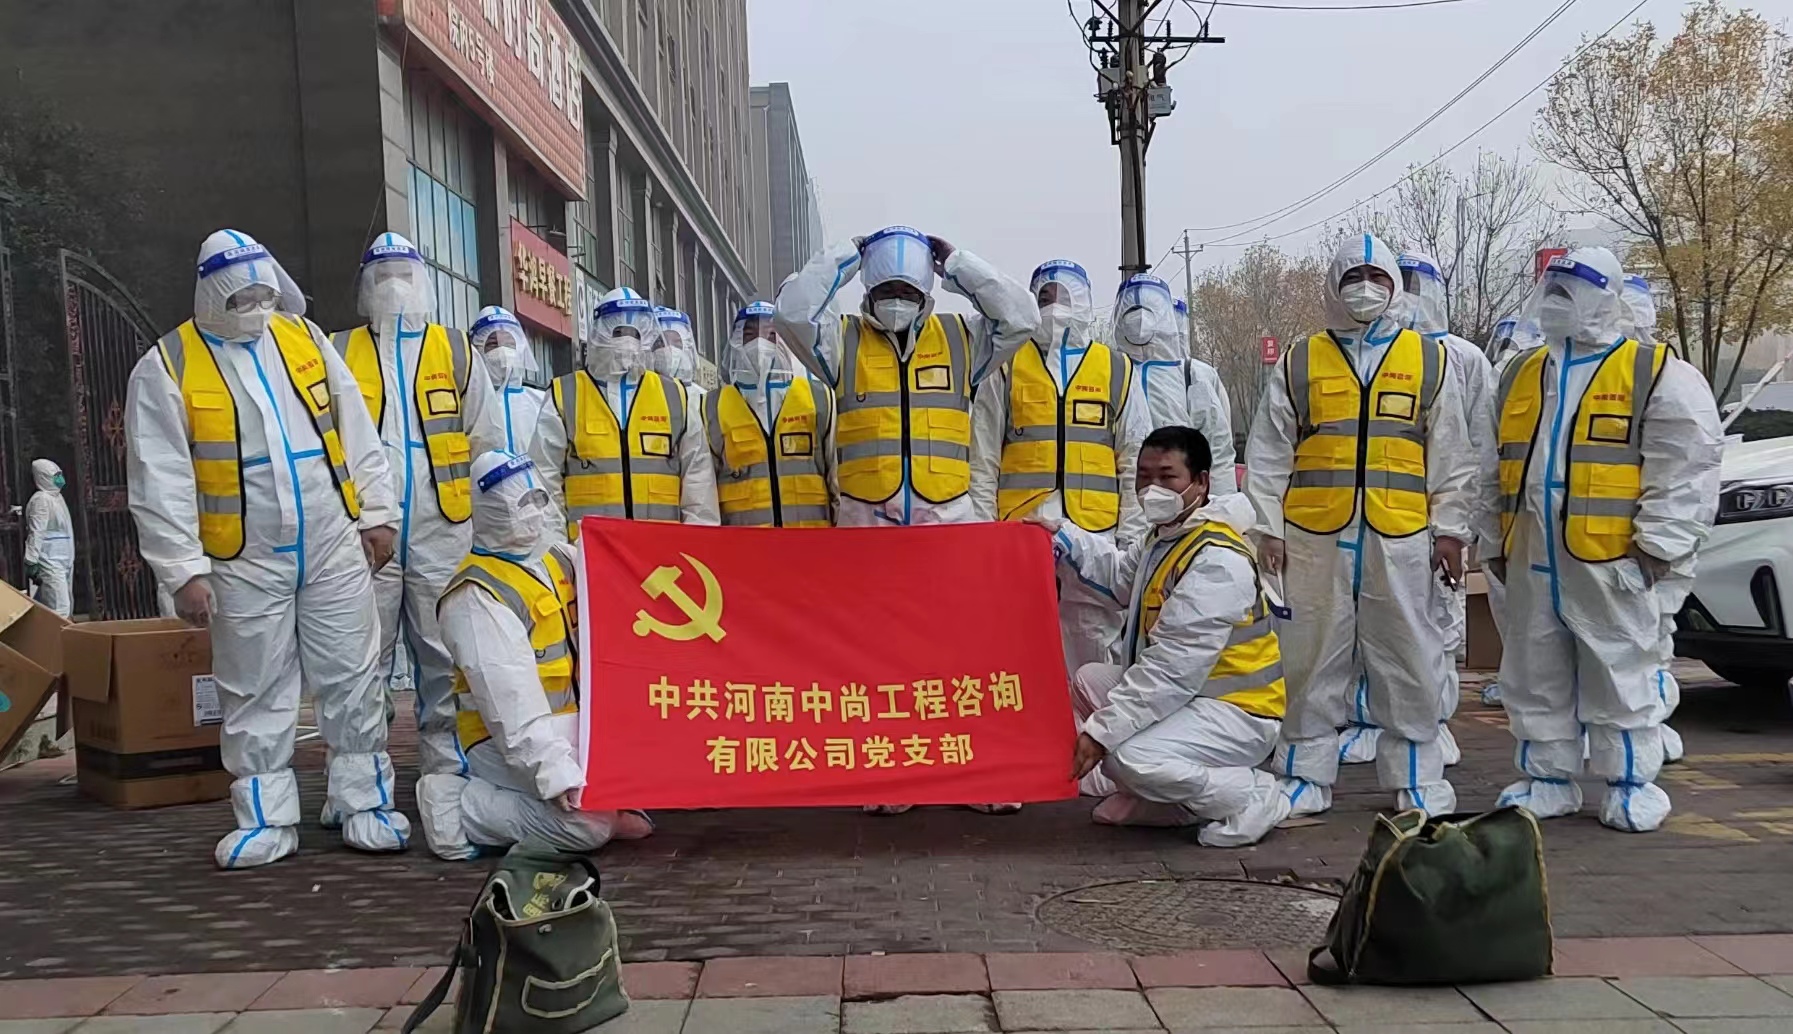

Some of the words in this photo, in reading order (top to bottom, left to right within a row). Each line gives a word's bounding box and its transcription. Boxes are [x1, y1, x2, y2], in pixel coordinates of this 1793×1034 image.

[449, 1, 495, 88] 院内5号楼
[648, 671, 1024, 723] 中共河南中尚工程咨询
[706, 733, 974, 774] 有限公司党支部
